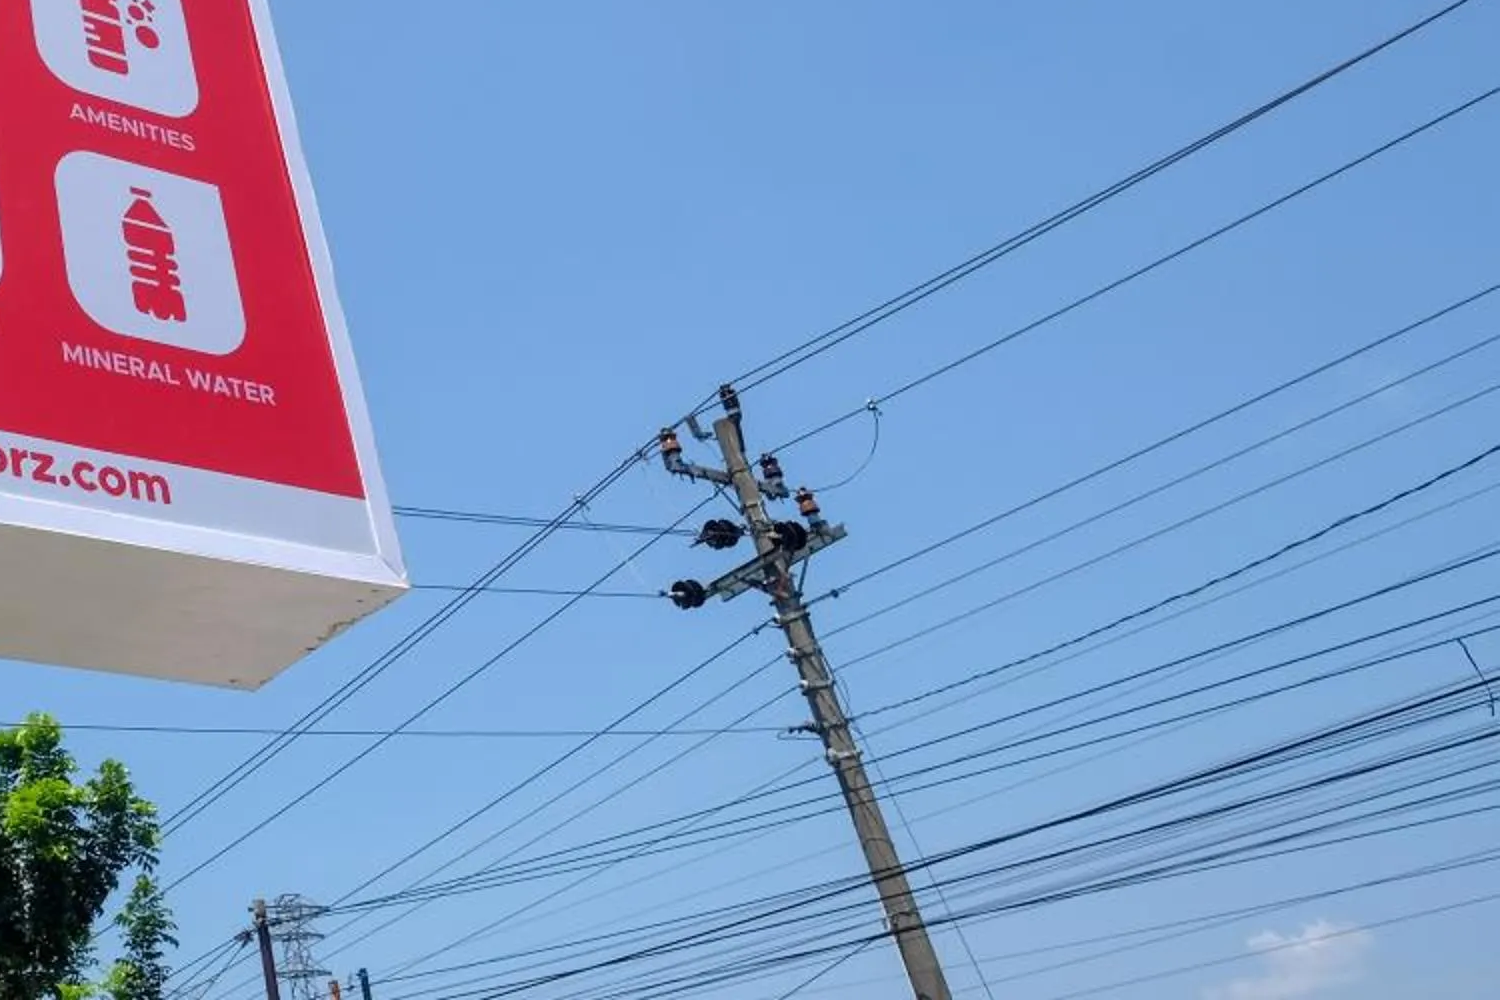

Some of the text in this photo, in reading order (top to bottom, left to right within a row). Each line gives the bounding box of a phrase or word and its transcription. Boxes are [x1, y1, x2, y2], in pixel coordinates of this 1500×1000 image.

[69, 103, 196, 153] AMENITIES
[62, 341, 276, 406] MINERAL WATER
